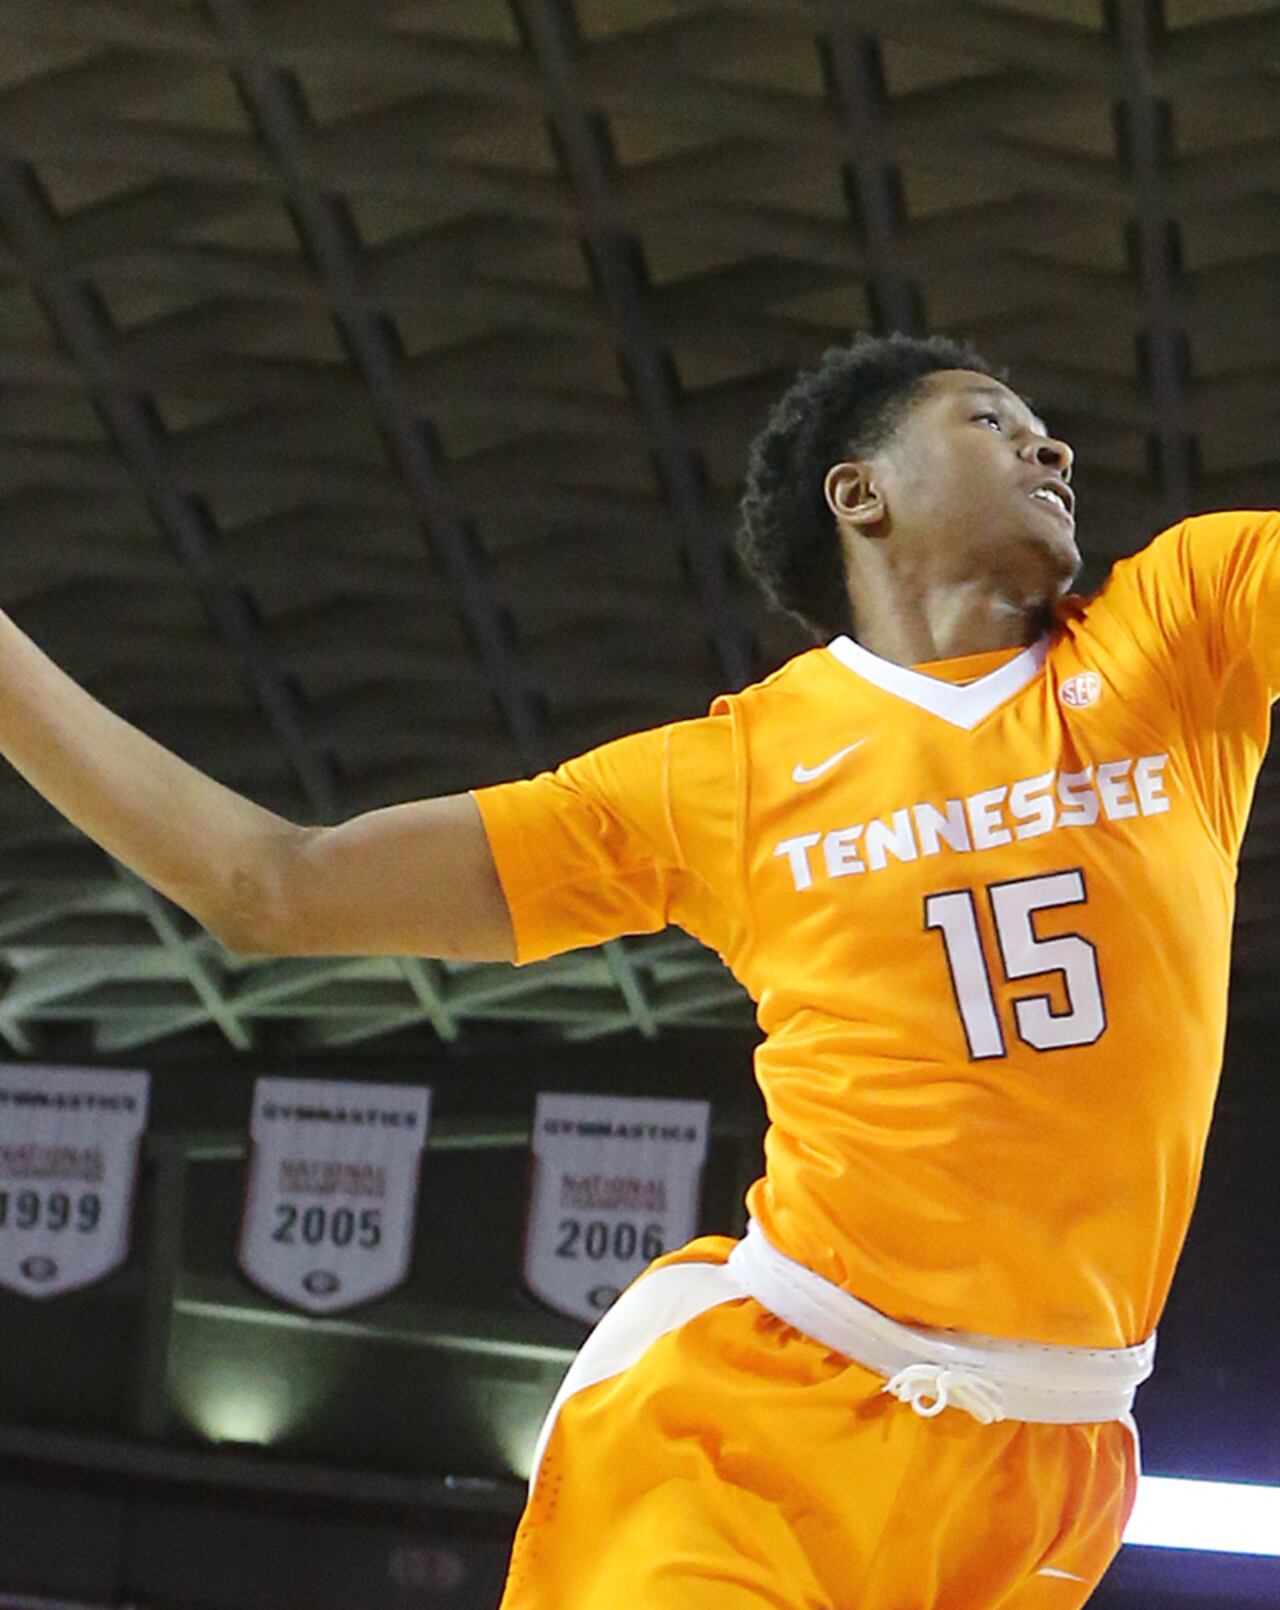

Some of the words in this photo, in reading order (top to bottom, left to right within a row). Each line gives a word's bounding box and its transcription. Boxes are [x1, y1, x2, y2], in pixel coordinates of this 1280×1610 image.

[1062, 674, 1100, 706] SEC
[774, 754, 1171, 892] TENNESSEE
[923, 867, 1108, 1062] 15
[272, 1204, 382, 1249] 2005
[555, 1219, 664, 1261] 2006
